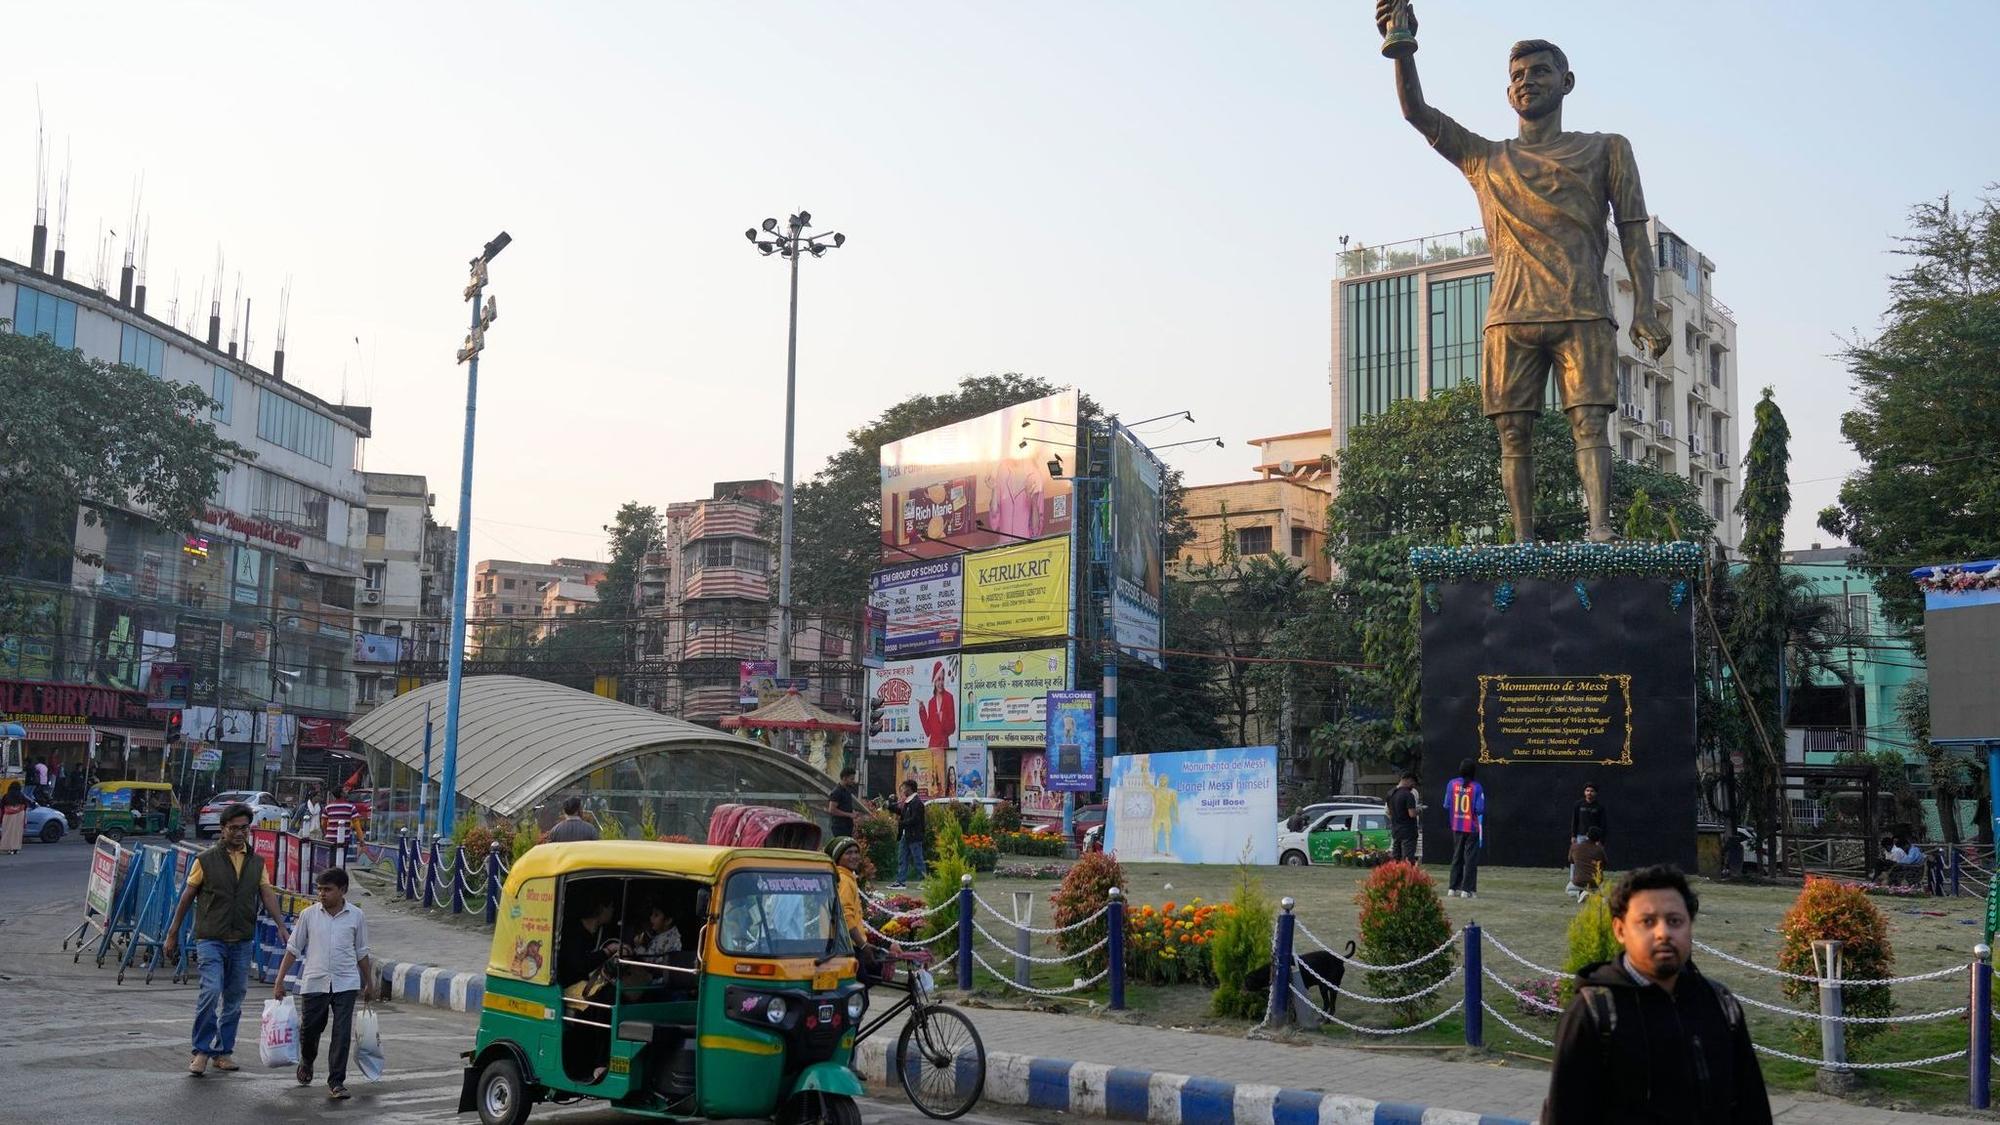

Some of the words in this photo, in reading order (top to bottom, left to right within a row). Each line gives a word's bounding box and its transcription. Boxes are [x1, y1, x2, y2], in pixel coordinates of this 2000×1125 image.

[915, 504, 931, 521] Rich
[932, 501, 952, 518] Marie
[881, 575, 891, 583] IEM
[892, 571, 910, 580] GROUP
[911, 568, 920, 577] OF
[920, 562, 949, 576] SCHOOLS
[978, 558, 1050, 584] KARUKRIT
[916, 593, 931, 601] PUBLIC
[939, 589, 954, 597] PUBLIC
[915, 602, 933, 611] SCHOOL
[937, 599, 956, 608] SCHOOL
[894, 605, 911, 615] SCHOOL
[1496, 681, 1560, 692] Monumento
[1562, 680, 1575, 691] de
[1576, 681, 1608, 692] Messi
[42, 687, 119, 718] BIRYANI
[1499, 695, 1536, 703] Inaugurated
[1536, 695, 1544, 704] by
[1585, 695, 1608, 704] himself
[1545, 706, 1553, 714] of
[17, 714, 57, 723] RESTAURANT
[1525, 717, 1560, 725] Government
[1562, 717, 1570, 725] of
[1587, 716, 1611, 725] Bengal
[1561, 727, 1588, 735] Sporting
[1183, 761, 1230, 773] Monumento
[1231, 760, 1241, 770] de
[1243, 759, 1266, 769] Messi
[1177, 780, 1206, 792] Lionel
[1208, 780, 1233, 790] Messi
[1236, 778, 1270, 790] himself
[1201, 799, 1220, 807] Sujit
[1454, 793, 1470, 813] 10
